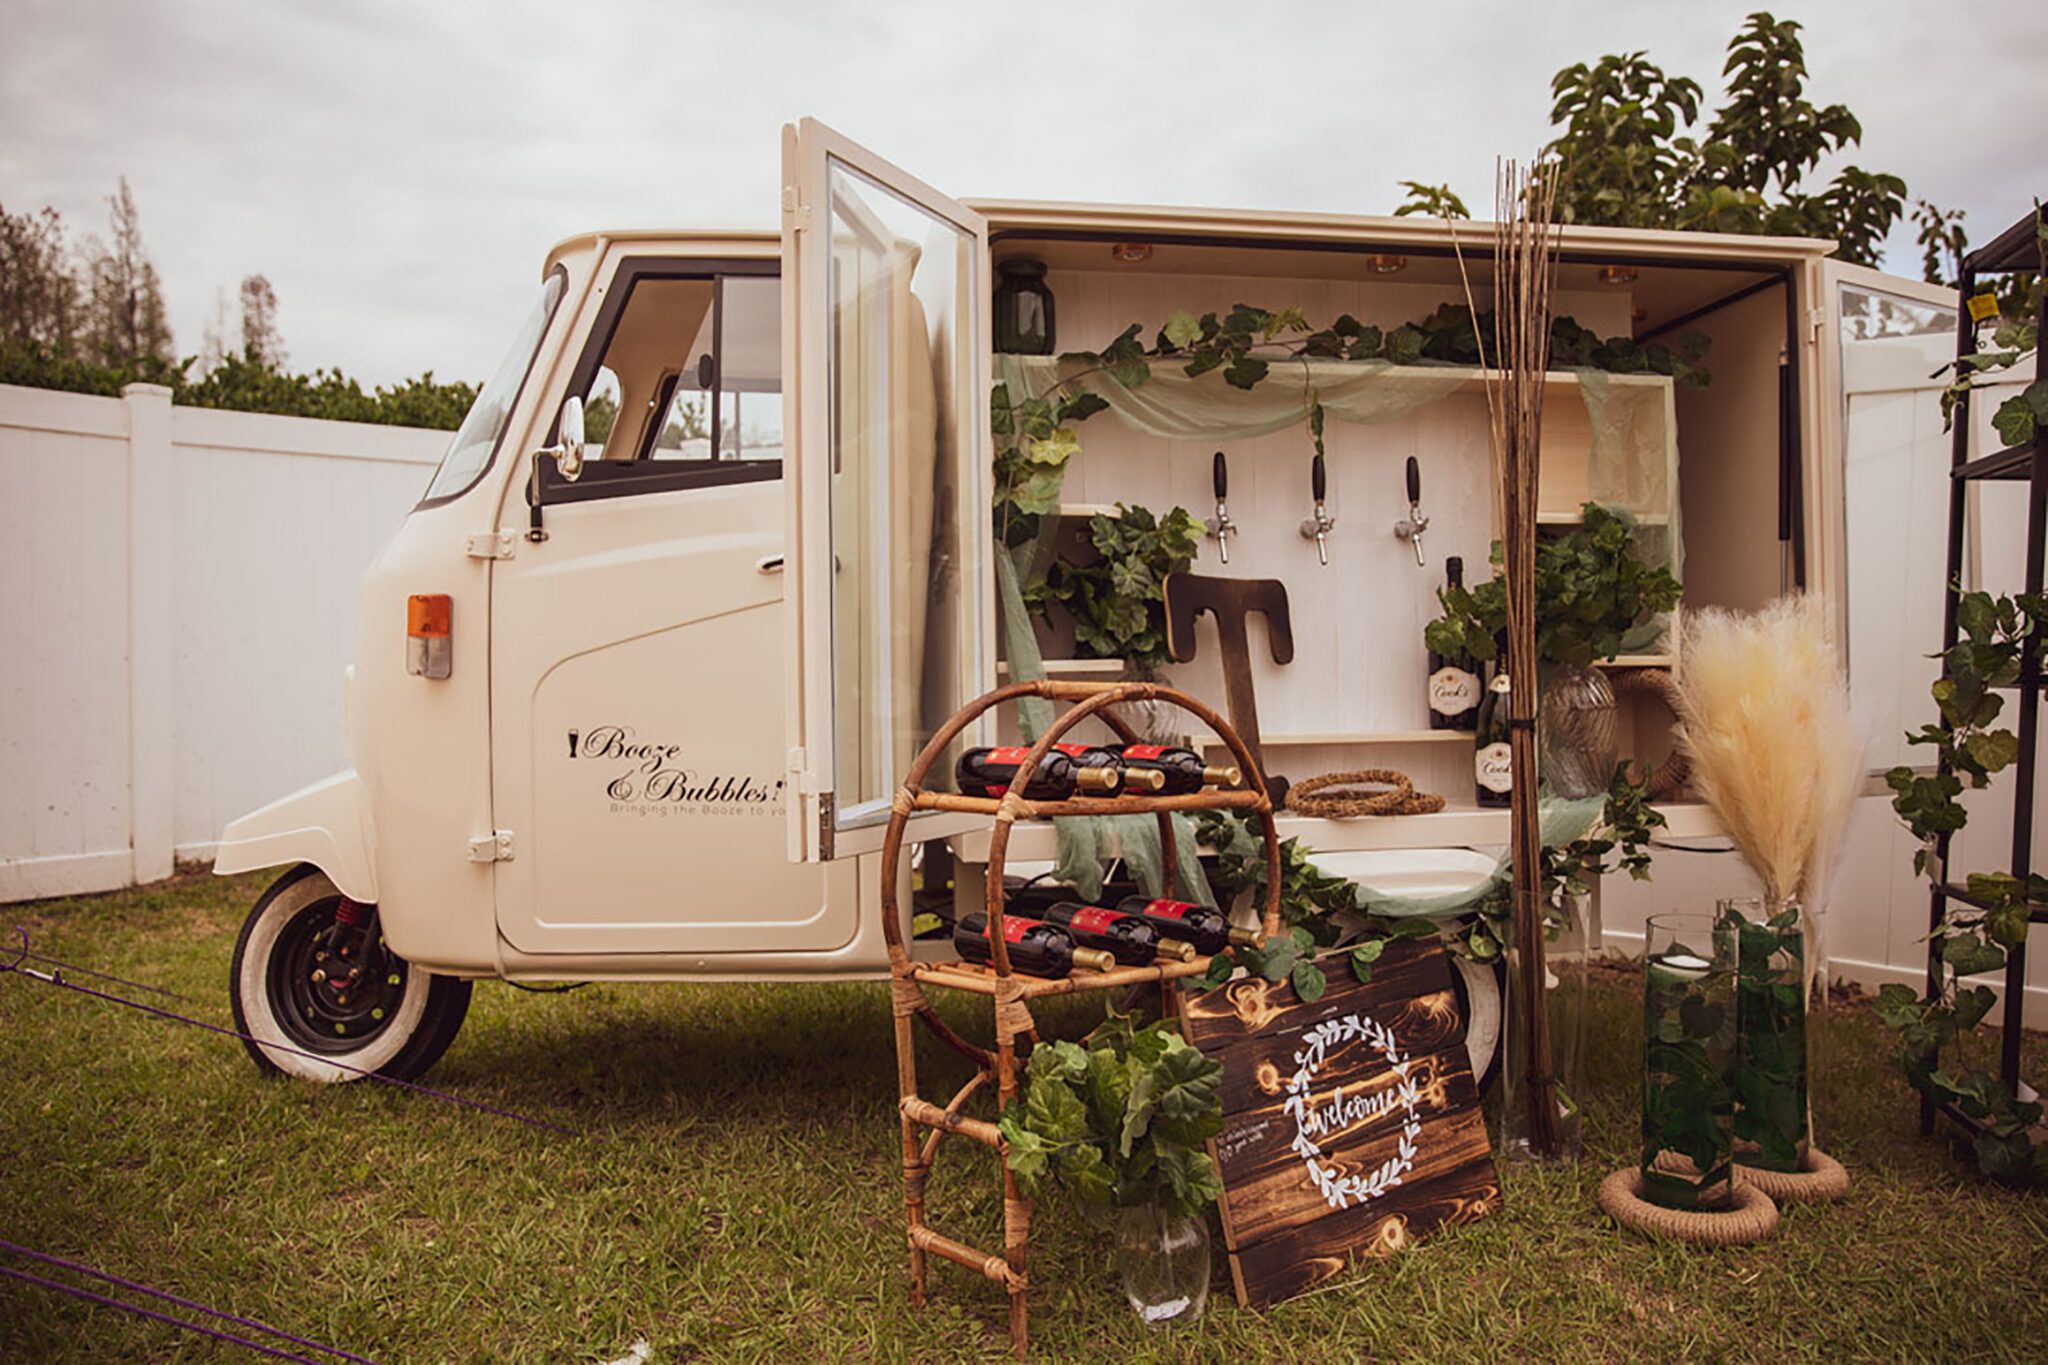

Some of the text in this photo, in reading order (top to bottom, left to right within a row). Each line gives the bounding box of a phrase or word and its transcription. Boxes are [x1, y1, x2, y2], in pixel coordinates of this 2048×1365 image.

[582, 726, 681, 774] Booze
[607, 769, 768, 803] & Bubbles
[610, 803, 786, 818] Bringing the Booze to yo
